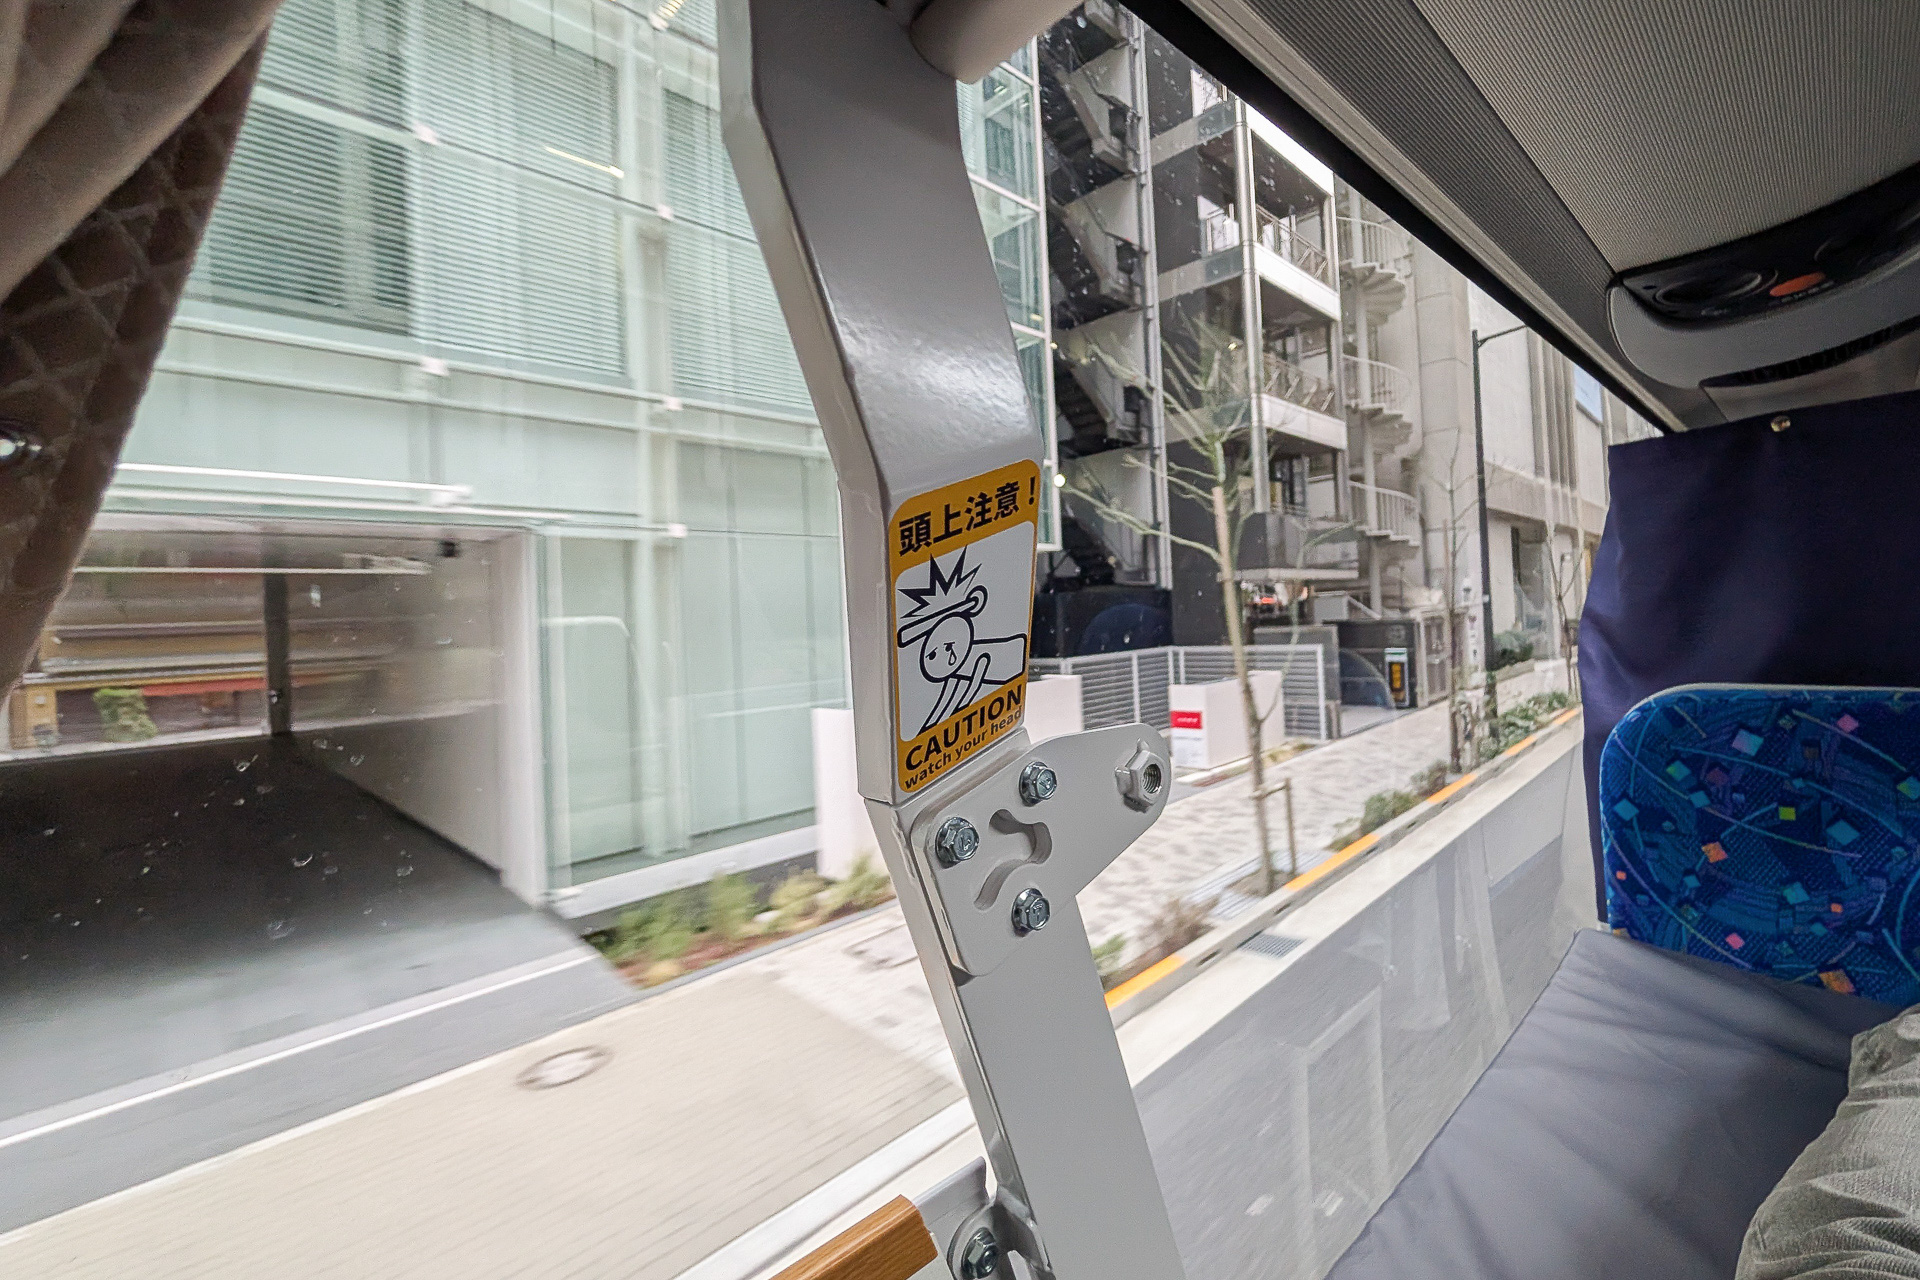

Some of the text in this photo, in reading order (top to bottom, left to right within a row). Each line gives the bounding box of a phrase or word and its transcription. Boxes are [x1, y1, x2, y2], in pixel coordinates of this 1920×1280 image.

[905, 684, 1022, 771] CAUTION
[905, 705, 1022, 789] watch your head
